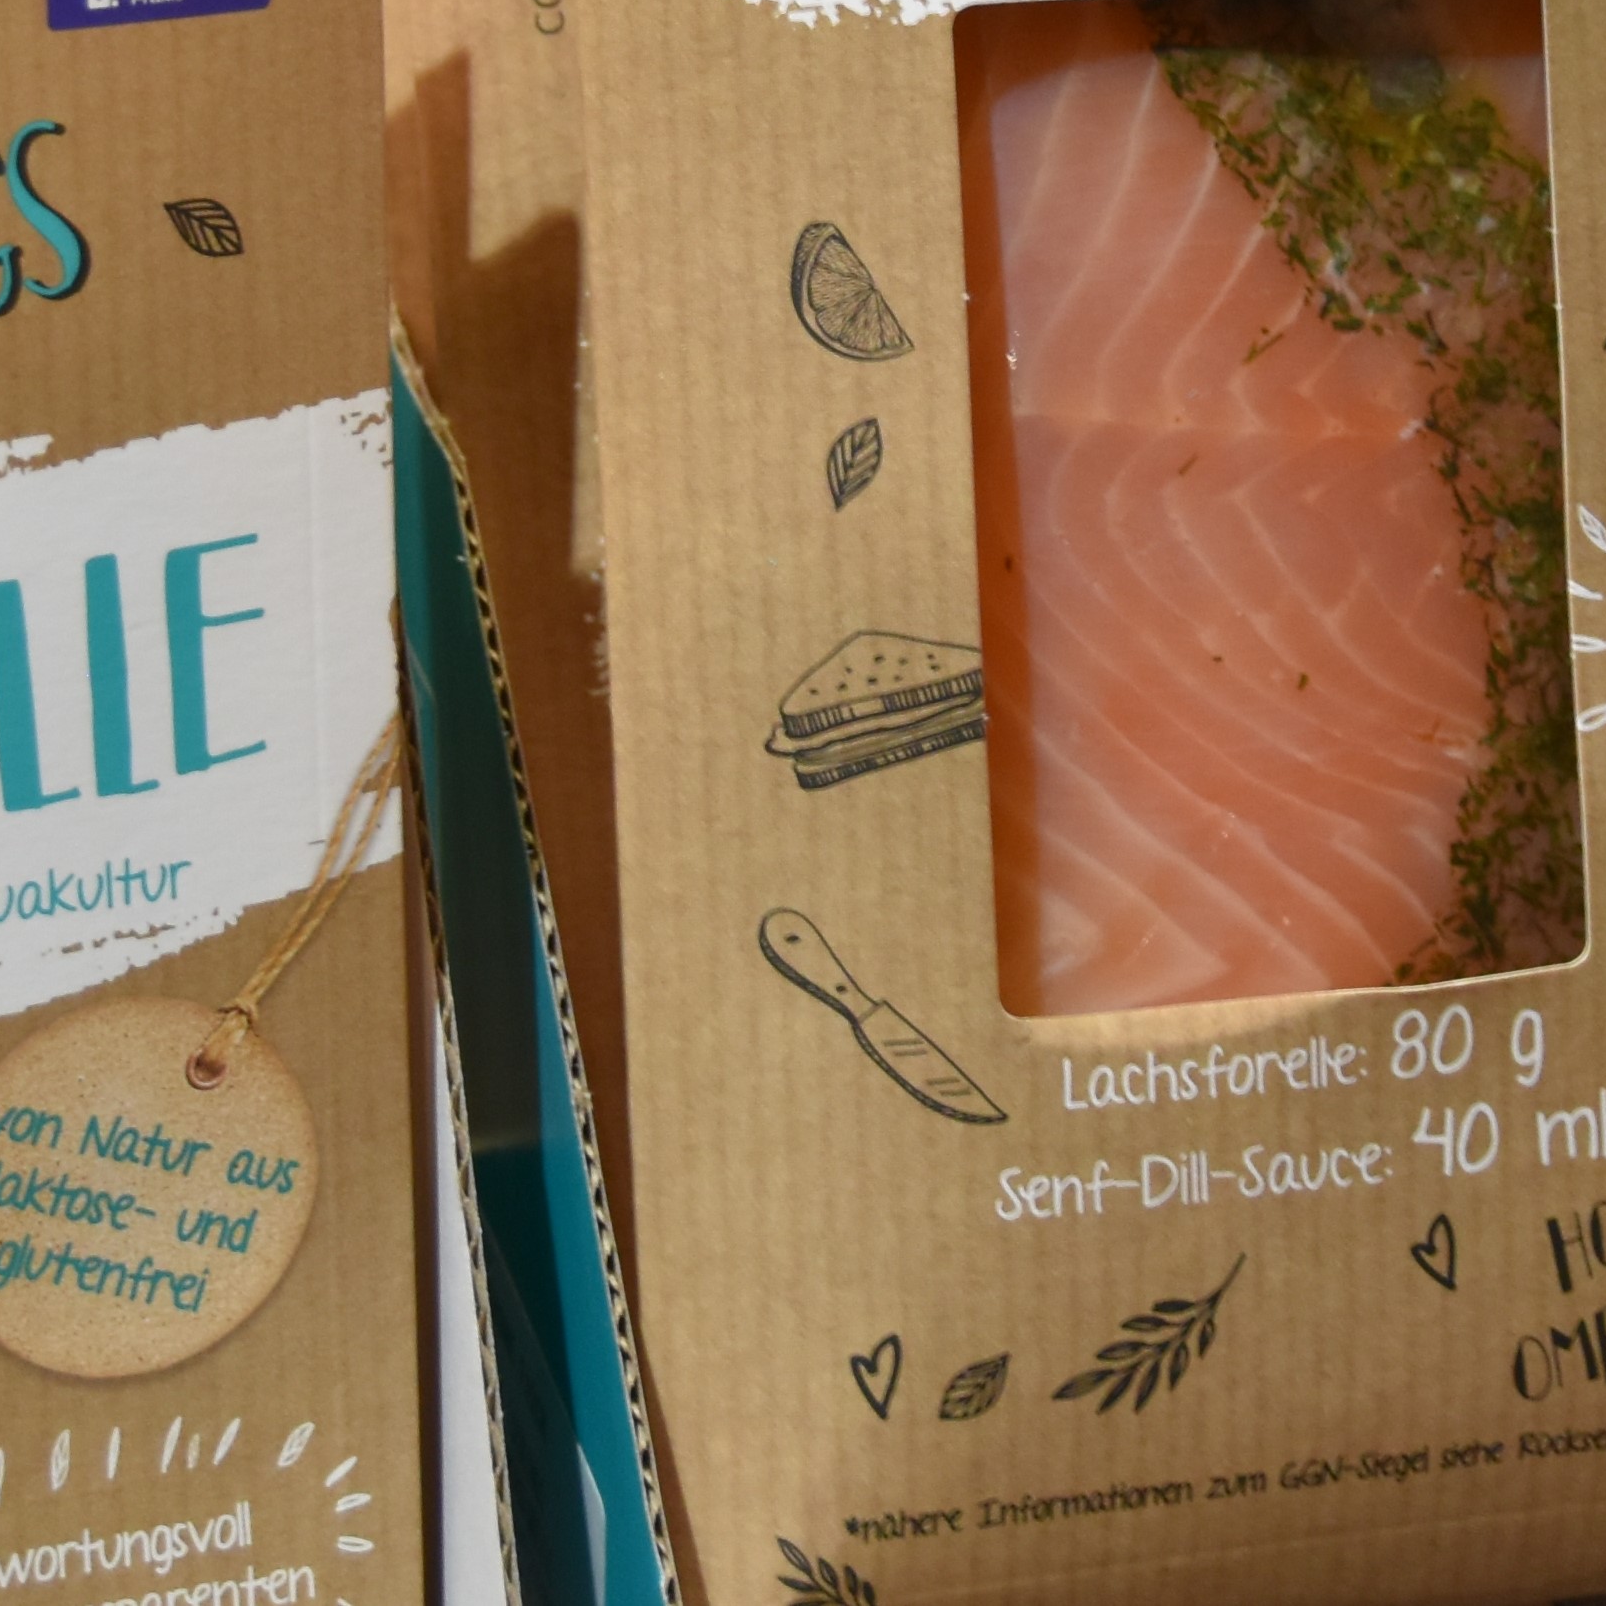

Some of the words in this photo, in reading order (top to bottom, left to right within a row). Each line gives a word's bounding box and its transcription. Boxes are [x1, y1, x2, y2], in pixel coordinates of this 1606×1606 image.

[1062, 1035, 1368, 1111] Lachsforelle:
[1389, 1004, 1474, 1080] 80
[1510, 1008, 1545, 1087] g
[79, 1114, 212, 1177] Natur
[226, 1148, 300, 1194] aus
[1412, 1100, 1499, 1178] 40
[176, 1207, 258, 1254] und
[977, 1478, 1193, 1530] Informationen
[1206, 1470, 1268, 1501] zum
[1279, 1446, 1429, 1491] GGN-Siegel
[1440, 1439, 1504, 1470] siehe
